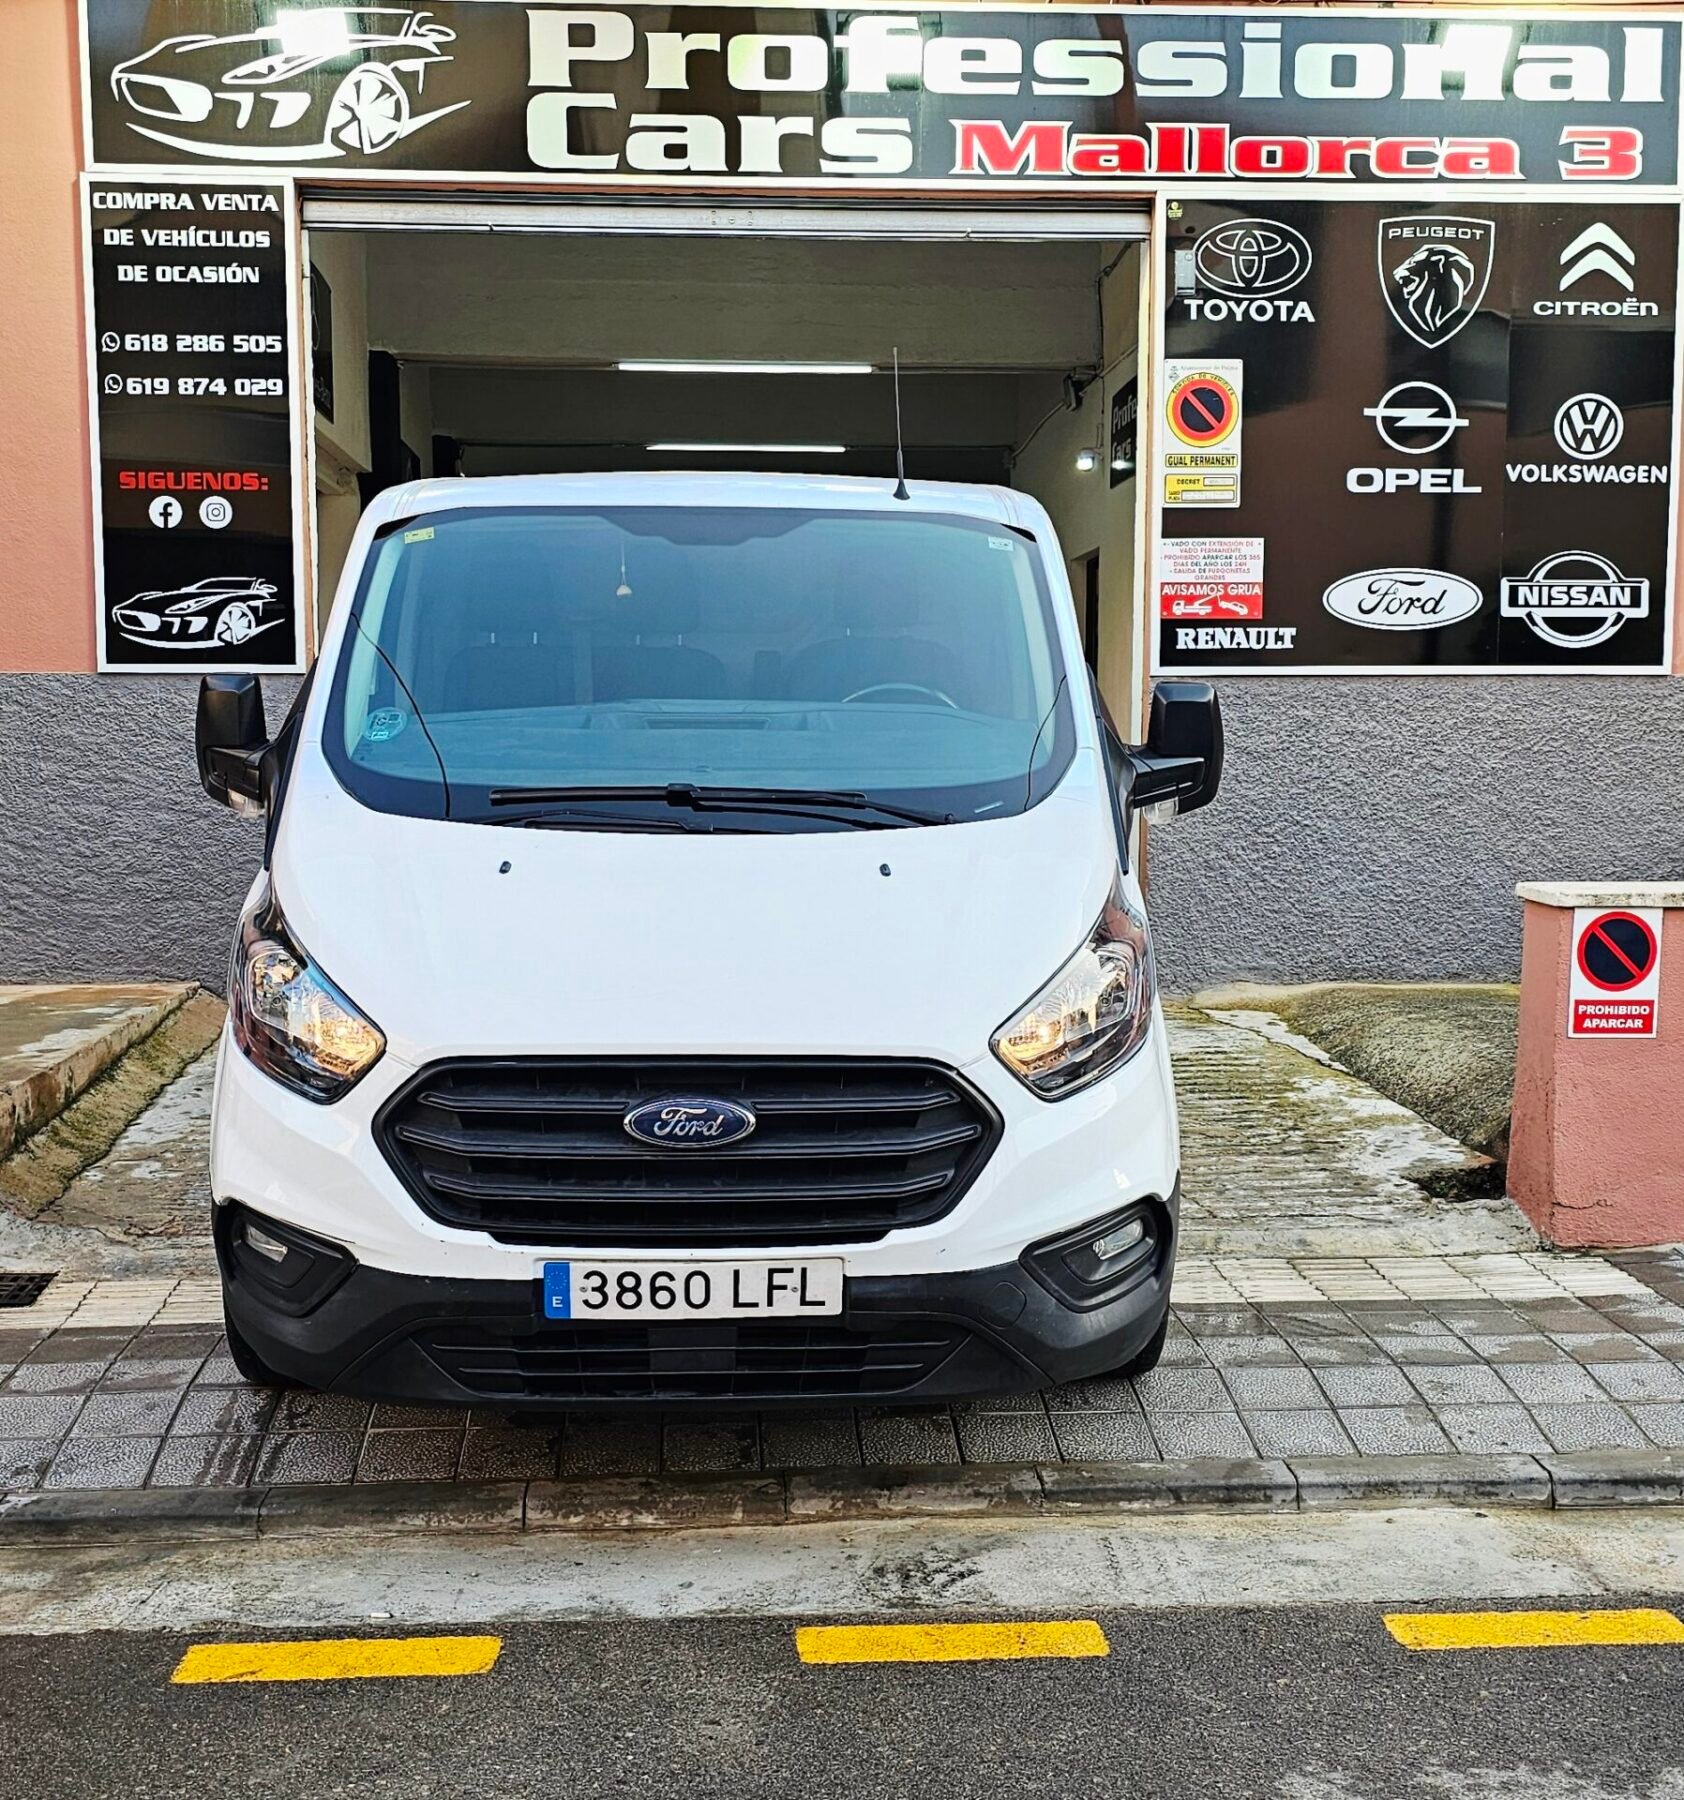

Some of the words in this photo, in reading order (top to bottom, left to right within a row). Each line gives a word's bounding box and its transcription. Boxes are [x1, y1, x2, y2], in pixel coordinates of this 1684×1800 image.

[526, 9, 1665, 103] Professional
[526, 91, 914, 173] Cars
[948, 118, 1527, 180] Mallorca
[1558, 125, 1644, 181] 3
[92, 191, 195, 211] COMPRA
[200, 193, 280, 212] VENTA
[103, 228, 134, 246] DE
[140, 225, 271, 248] VEHÍCULOS
[1388, 226, 1485, 240] PEUGEOT
[117, 265, 149, 282] DE
[155, 262, 260, 283] OCASIÓN
[1184, 299, 1316, 323] TOYOTA
[124, 334, 169, 351] 618
[176, 334, 225, 352] 286
[233, 335, 283, 353] 505
[126, 377, 170, 395] 619
[178, 378, 227, 396] 874
[234, 378, 283, 396] 029
[1168, 455, 1188, 466] GUAL
[1189, 455, 1236, 466] PERMANENT
[119, 470, 269, 491] SIGUENOS:
[1346, 467, 1482, 493] OPEL
[1505, 463, 1668, 484] VOLKSWAGEN
[1161, 584, 1225, 596] AVISAMOS
[1227, 584, 1261, 596] GRUA
[1357, 577, 1448, 615] Ford
[1517, 585, 1632, 606] NISSAN
[1175, 627, 1297, 650] RENAULT
[1578, 1005, 1650, 1015] PROHIBIDO
[1582, 1018, 1644, 1028] APARCAR
[653, 1107, 726, 1137] Ford
[552, 1296, 563, 1308] E
[581, 1270, 711, 1310] 3860
[732, 1267, 826, 1309] LFL
